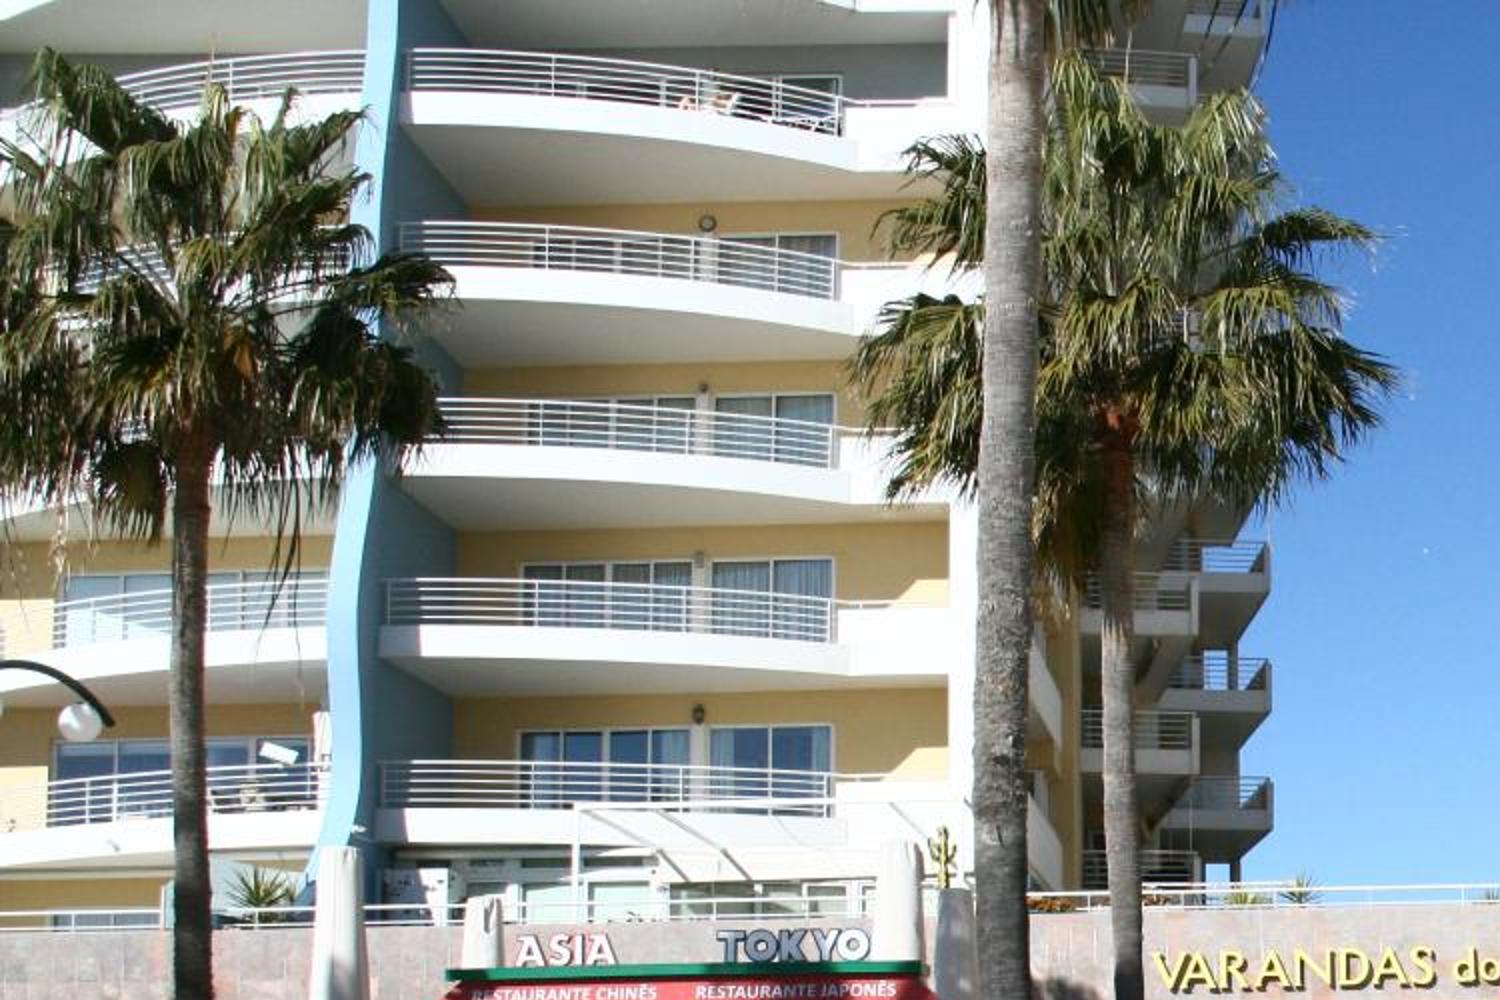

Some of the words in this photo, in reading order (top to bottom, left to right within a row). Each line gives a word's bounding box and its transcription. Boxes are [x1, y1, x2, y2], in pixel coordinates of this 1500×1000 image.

[515, 932, 617, 966] ASIA
[716, 928, 870, 962] TOKYO
[1151, 943, 1437, 994] VARANDAS
[694, 983, 816, 1000] RESTAURANTE
[820, 979, 897, 998] JAPONÊS
